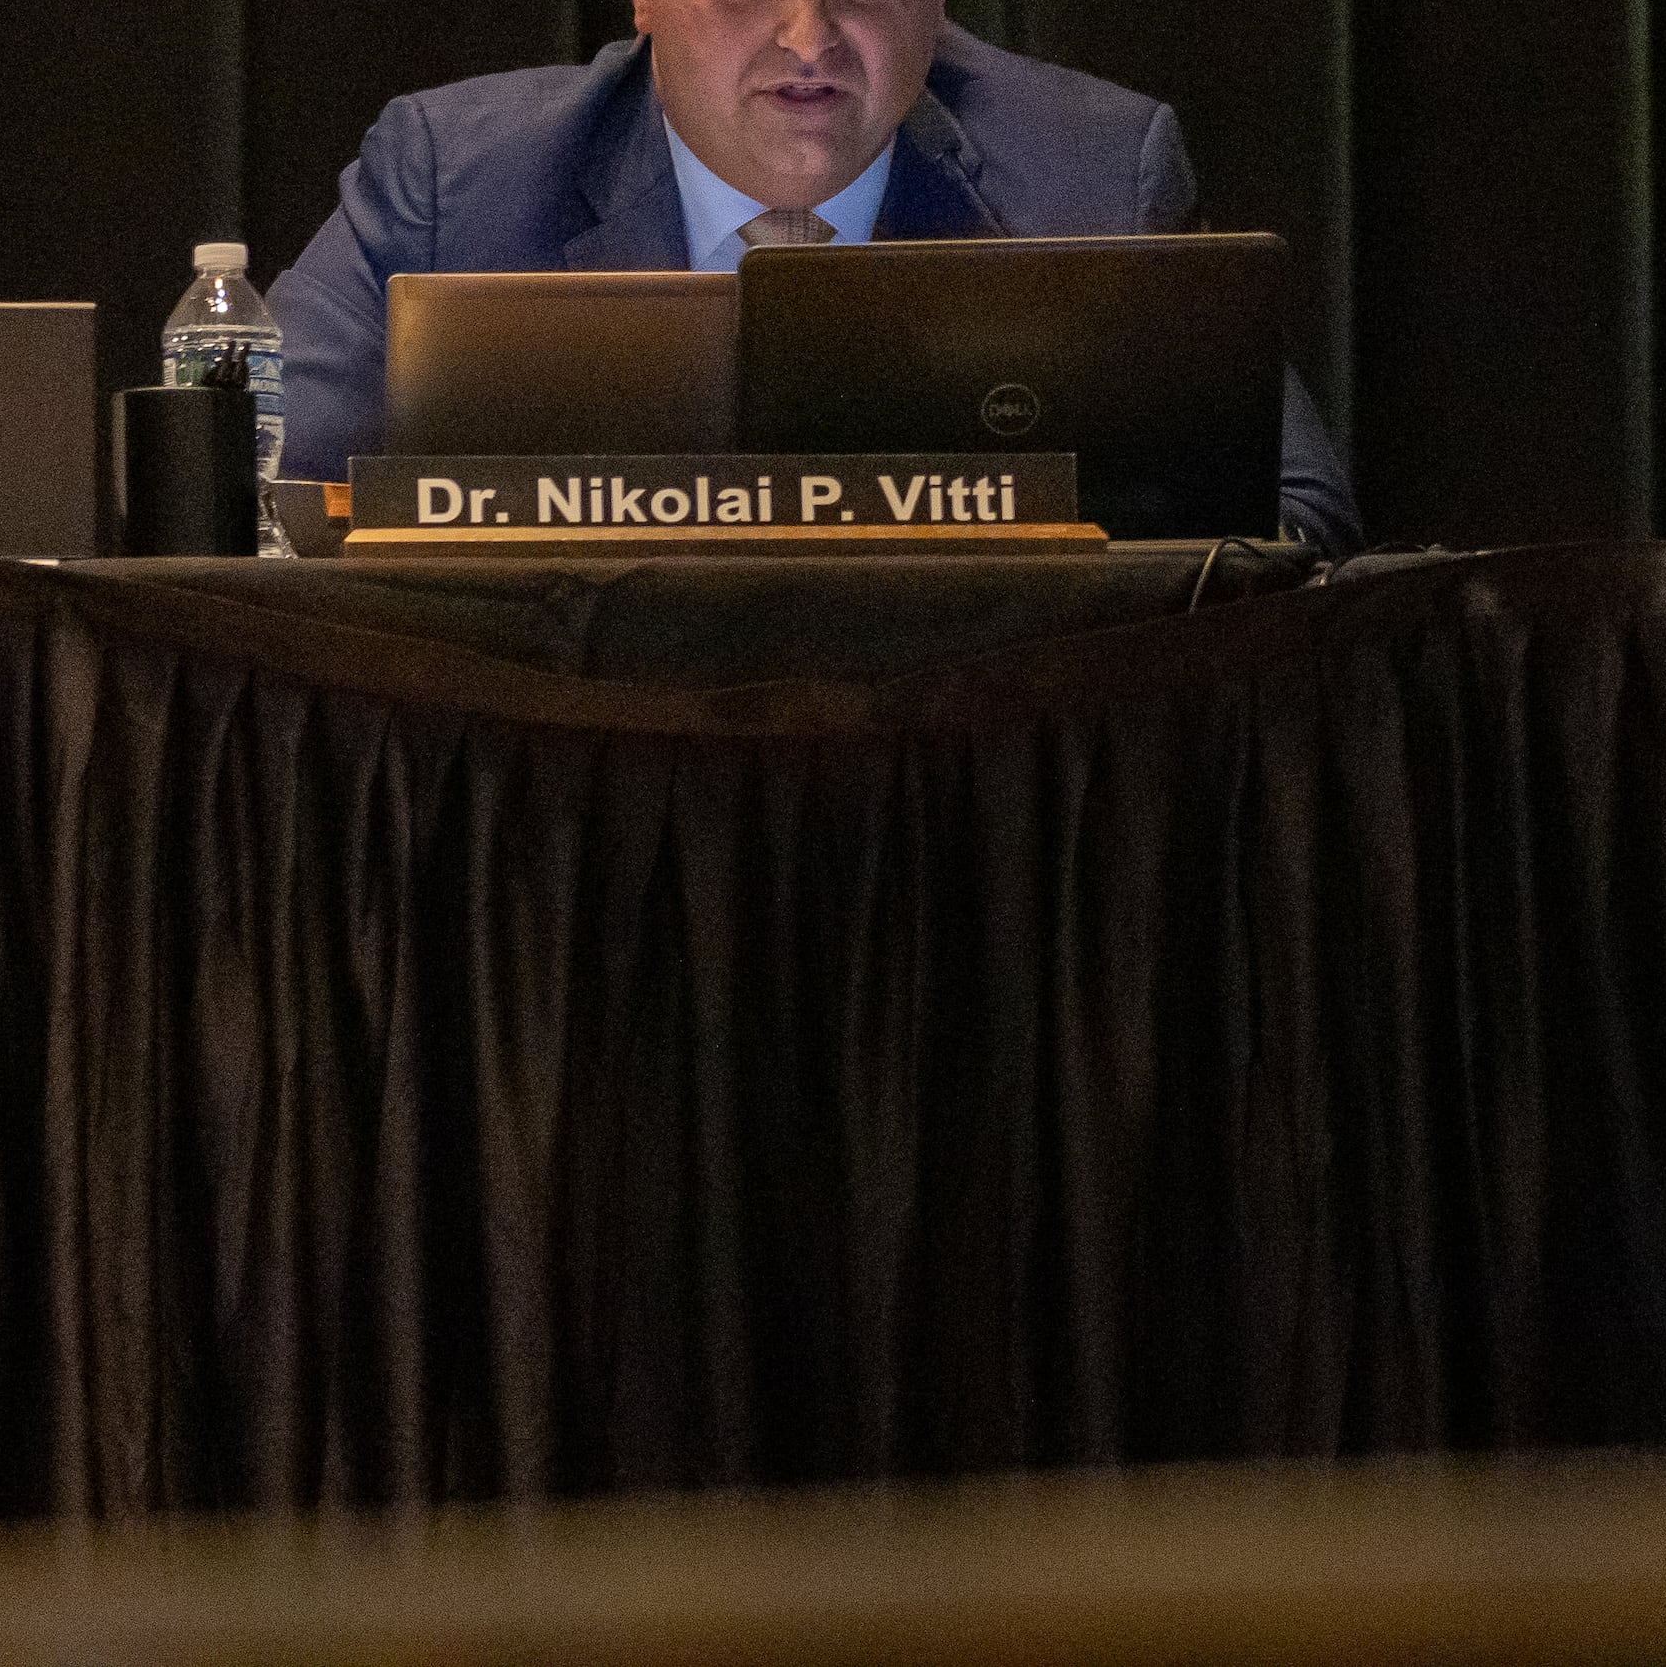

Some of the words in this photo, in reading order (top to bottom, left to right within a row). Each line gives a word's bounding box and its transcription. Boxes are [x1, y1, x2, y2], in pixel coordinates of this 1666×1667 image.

[416, 477, 510, 524] Dr.
[536, 475, 773, 524] Nikolai
[800, 475, 855, 522] P.
[877, 474, 1016, 522] Vitti
